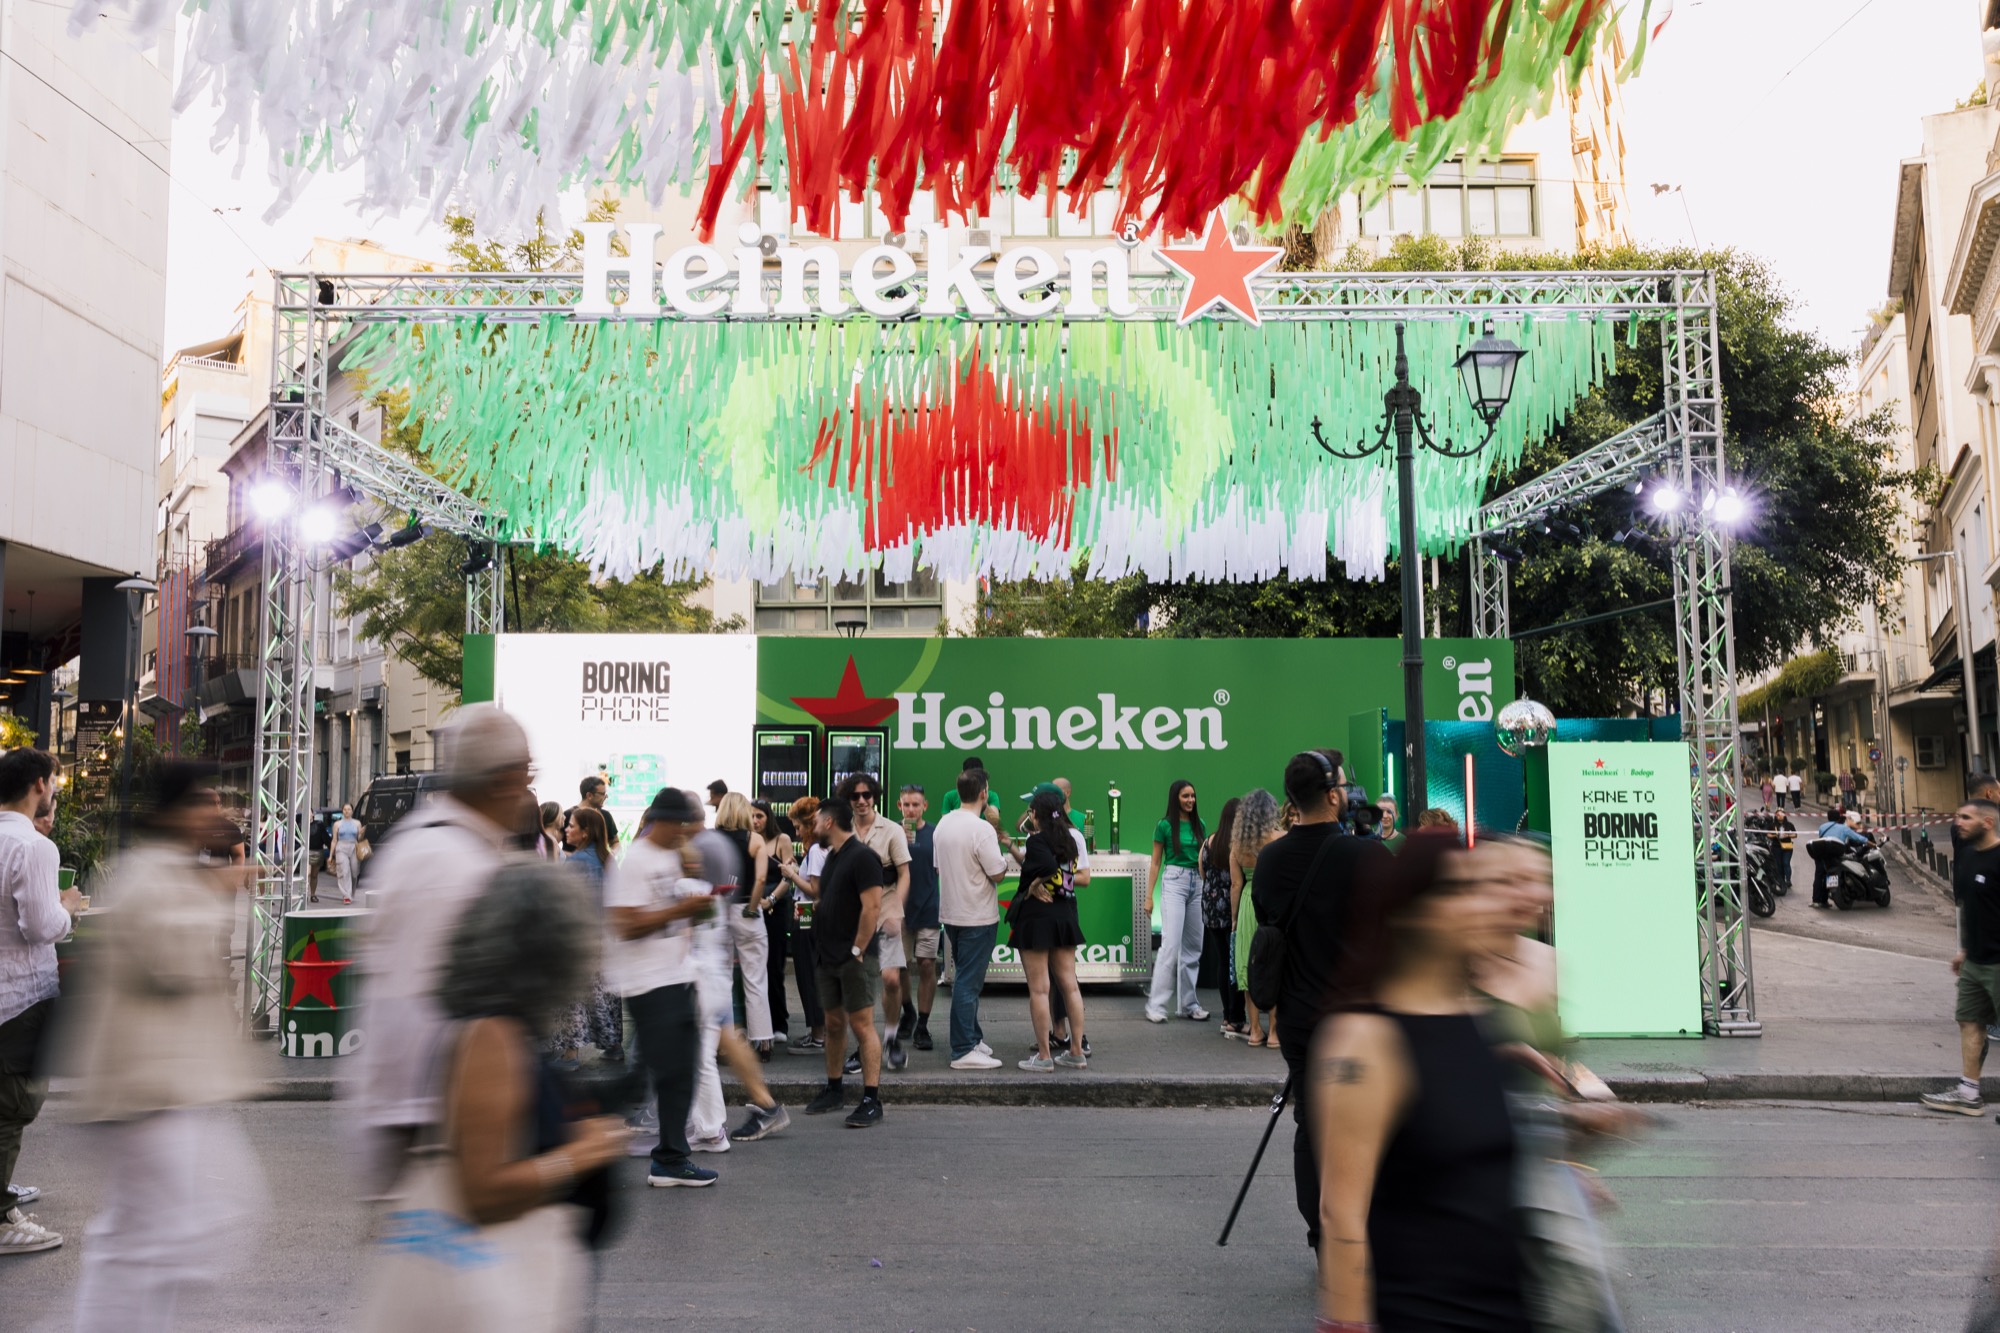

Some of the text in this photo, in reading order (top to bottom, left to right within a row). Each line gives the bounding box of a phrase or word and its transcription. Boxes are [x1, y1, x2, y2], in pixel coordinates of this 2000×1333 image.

[582, 661, 671, 694] BORING
[581, 695, 670, 722] PHONE
[1630, 768, 1655, 778] Bodega
[1582, 790, 1655, 803] KANE TO
[1584, 812, 1659, 839] BORING
[1585, 839, 1659, 861] PHONE
